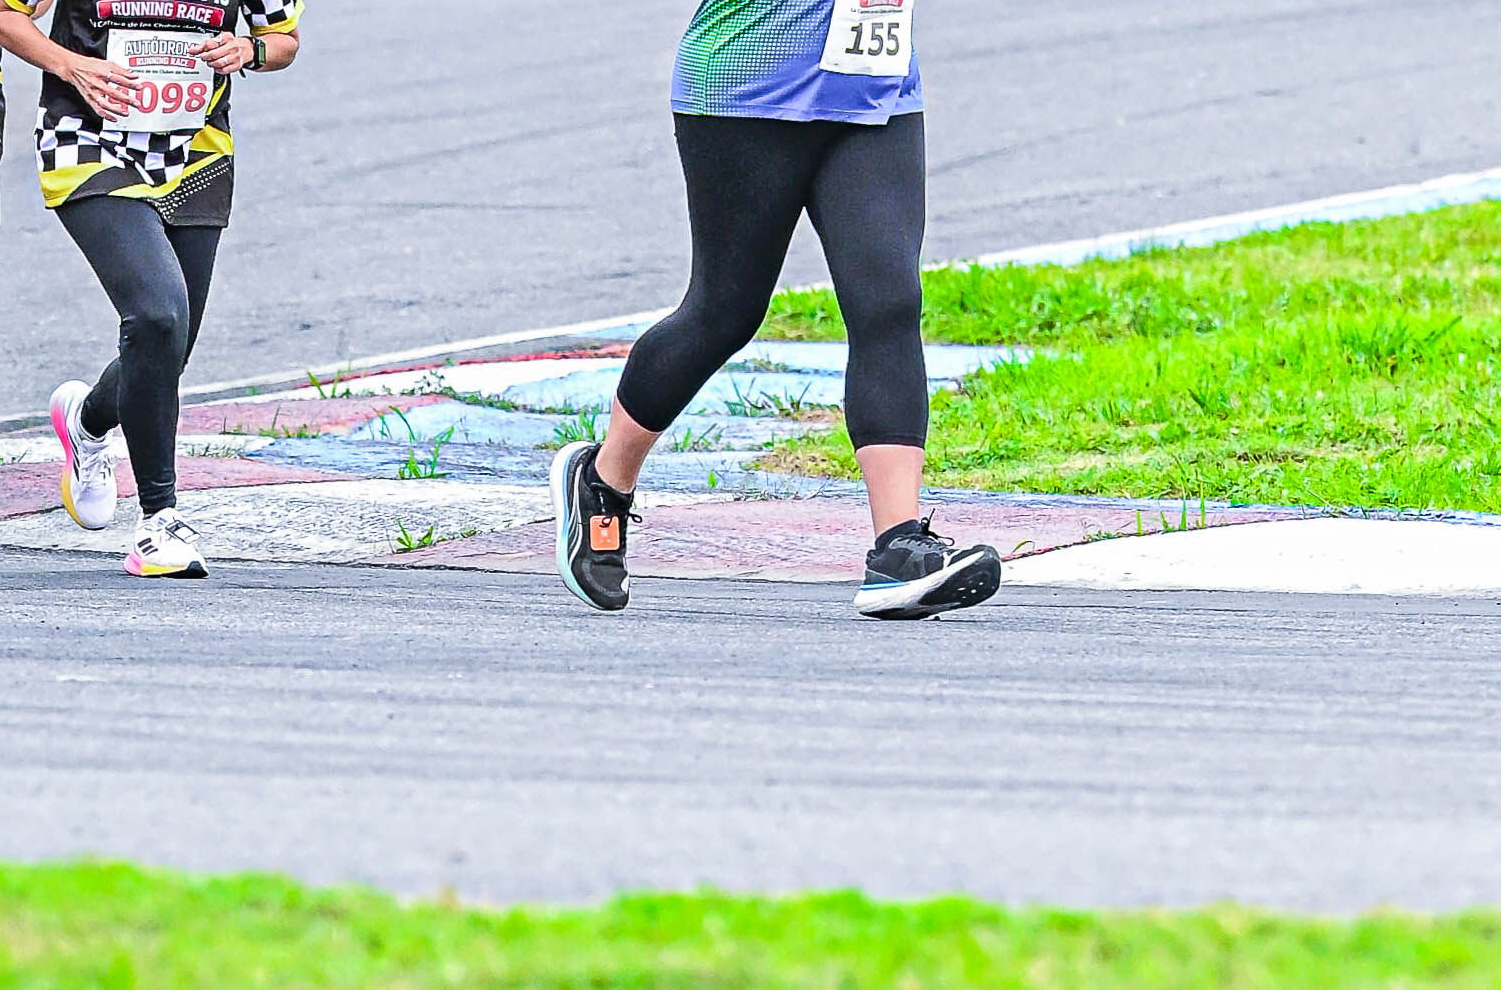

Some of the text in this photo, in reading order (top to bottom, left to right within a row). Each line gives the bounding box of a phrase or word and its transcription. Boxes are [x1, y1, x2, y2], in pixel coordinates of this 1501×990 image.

[111, 1, 214, 24] RUNNING RACE
[125, 36, 198, 57] AUTÓDROM
[845, 22, 900, 56] 155
